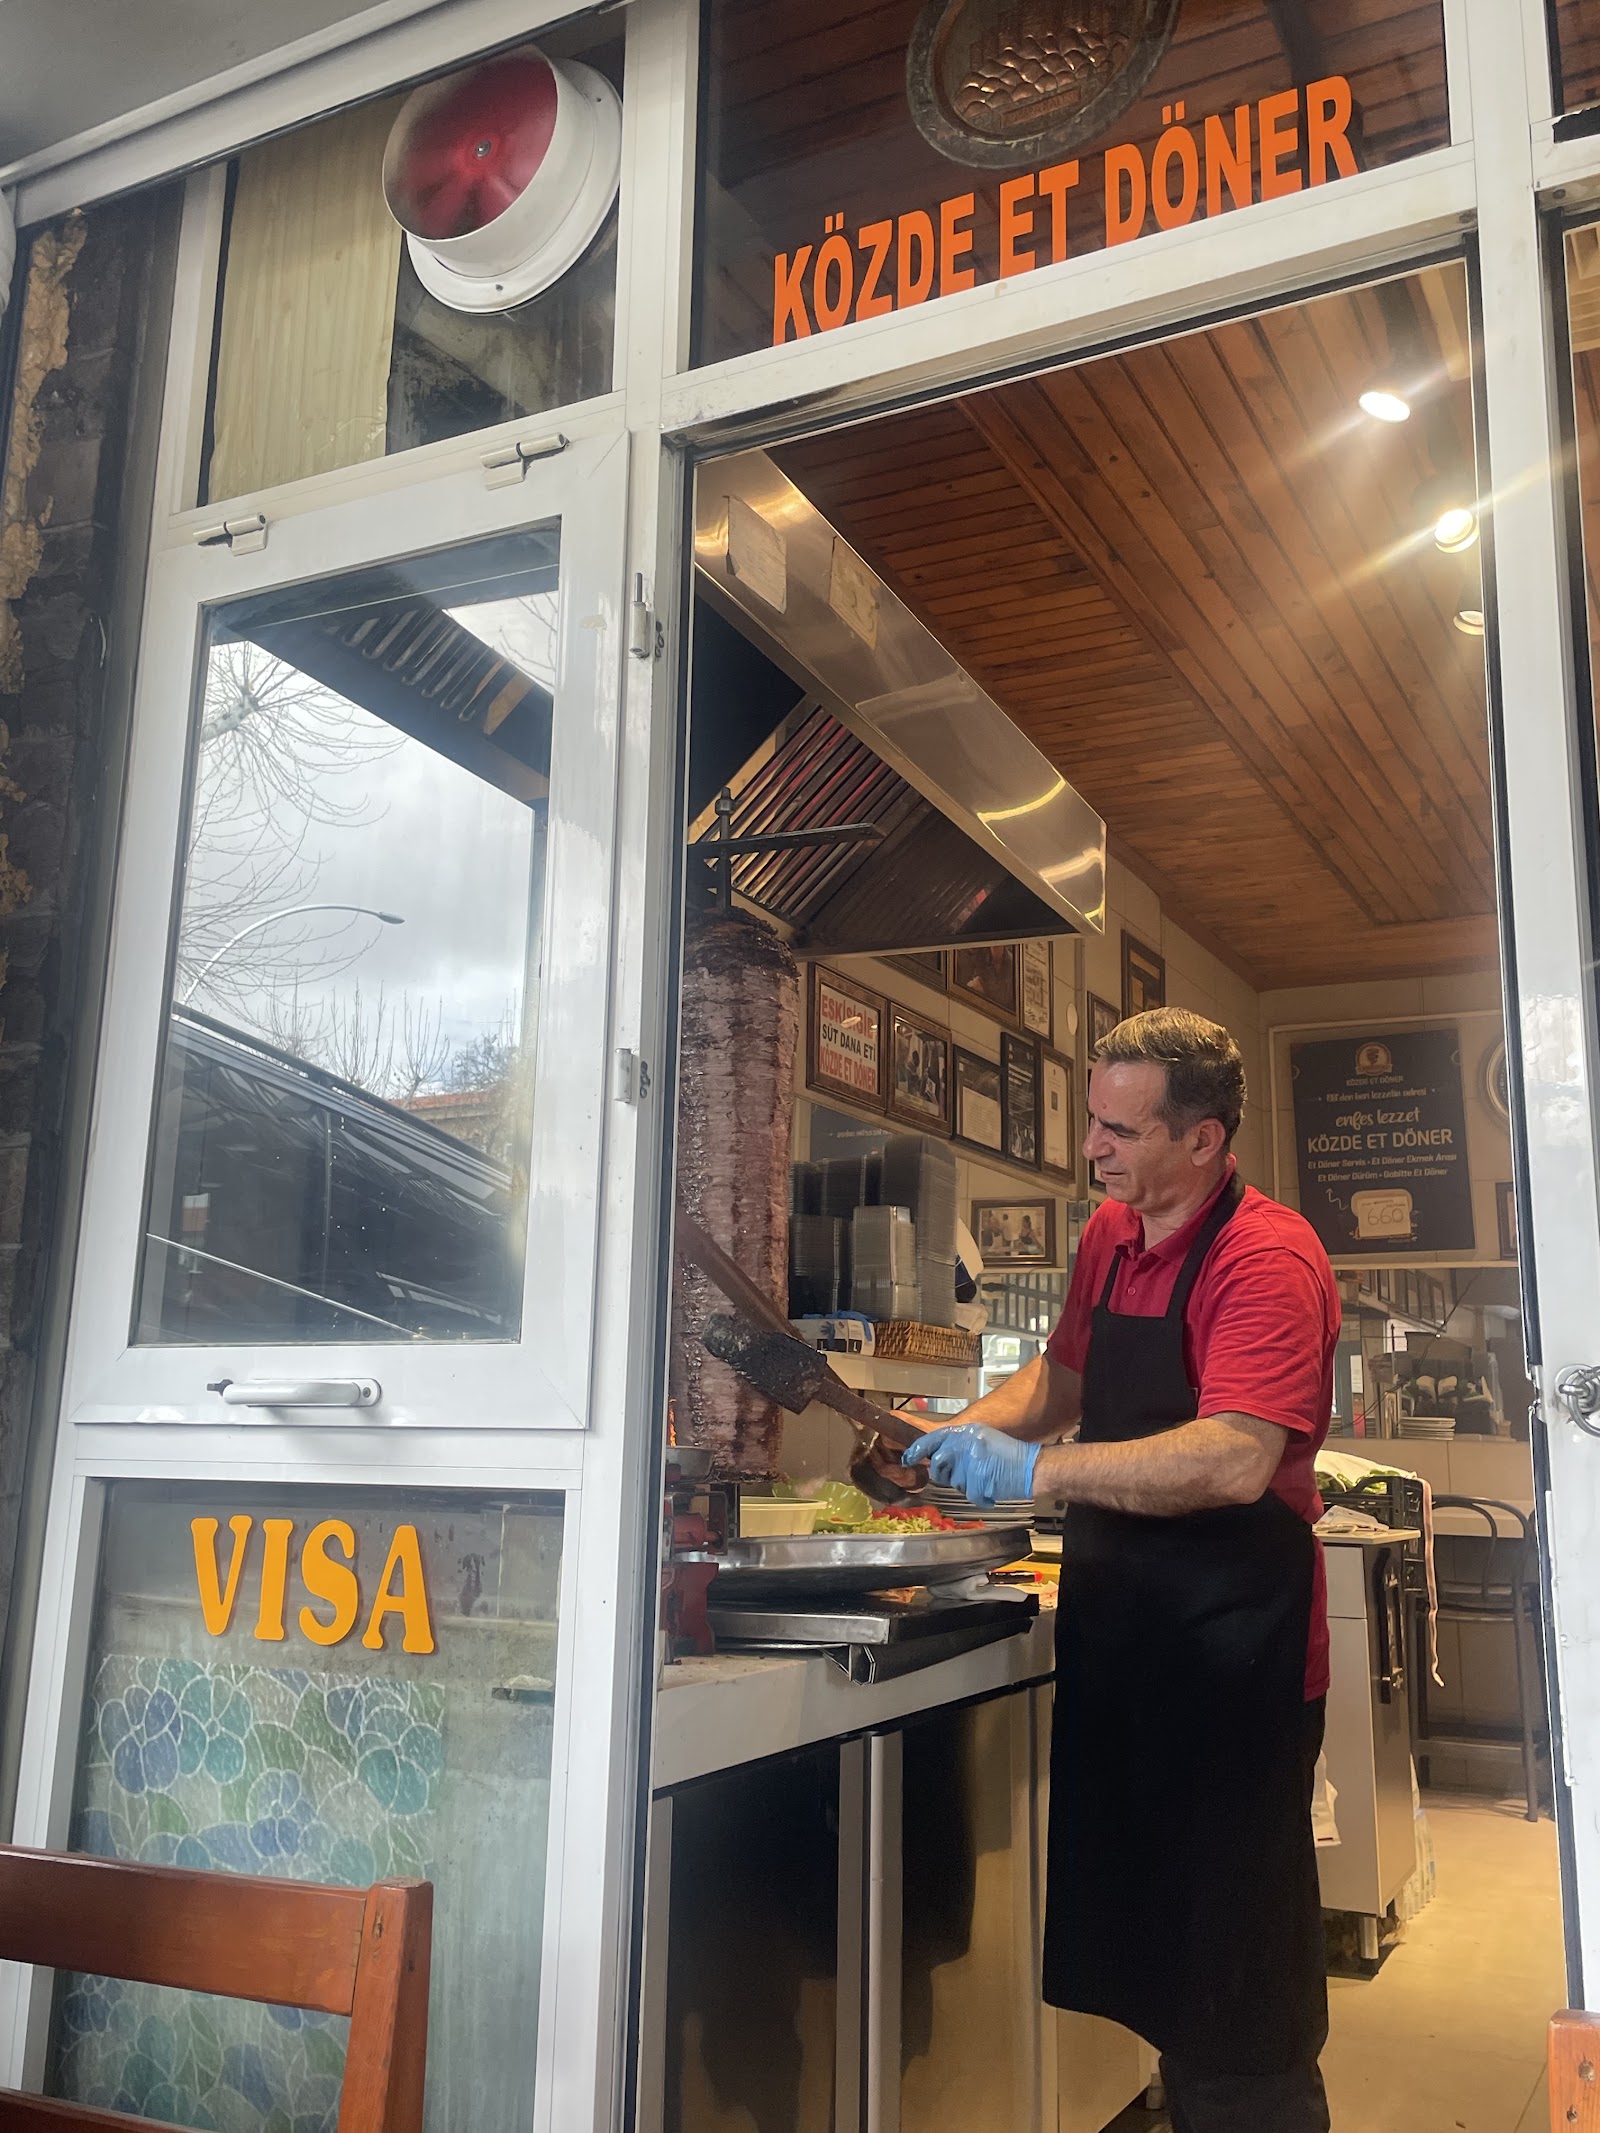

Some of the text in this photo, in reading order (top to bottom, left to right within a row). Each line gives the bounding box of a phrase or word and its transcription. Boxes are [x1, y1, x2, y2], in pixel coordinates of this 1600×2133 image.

[773, 75, 1360, 346] KÖZDE ET DÖNER
[822, 1022, 876, 1062] SÜT DANA ETİ
[820, 1044, 876, 1093] KÖZDE ET DÖNER
[1335, 1106, 1421, 1130] enfes lezzet
[1307, 1127, 1453, 1154] KÖZDE ET DÖNER
[1308, 1161, 1317, 1170] Et
[1317, 1160, 1340, 1169] Döner
[1341, 1158, 1366, 1168] Servis
[1371, 1157, 1381, 1166] Et
[1381, 1155, 1406, 1165] Döner
[1406, 1154, 1434, 1164] Ekmek
[1317, 1174, 1326, 1183] Et
[1327, 1173, 1350, 1182] Döner
[1351, 1171, 1378, 1181] Dürüm
[1413, 1169, 1423, 1178] Et
[1424, 1167, 1448, 1177] Döner
[1367, 1207, 1404, 1226] 660
[190, 1515, 435, 1654] VISA
